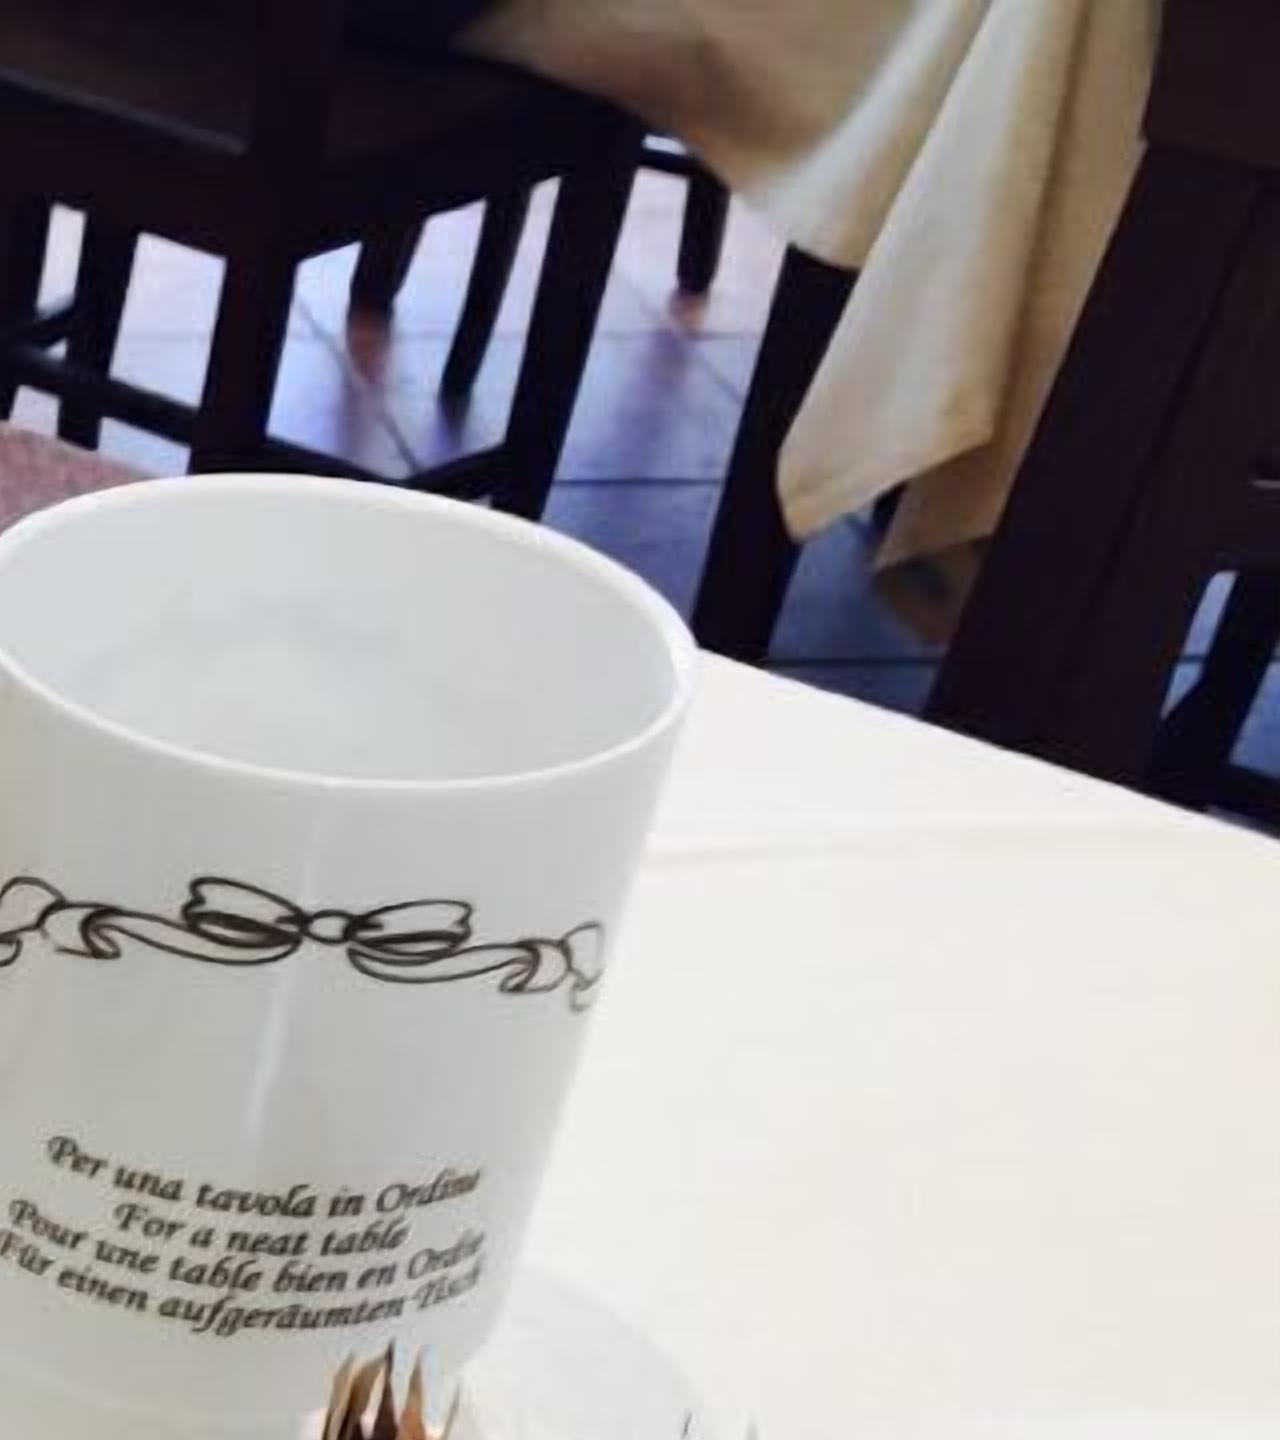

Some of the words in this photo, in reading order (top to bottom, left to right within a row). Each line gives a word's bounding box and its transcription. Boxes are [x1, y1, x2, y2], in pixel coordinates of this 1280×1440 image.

[48, 1135, 108, 1179] Per
[113, 1166, 184, 1201] una
[196, 1183, 316, 1217] tavola
[329, 1187, 364, 1217] in
[9, 1199, 88, 1248] Pour
[95, 1240, 160, 1273] une
[169, 1256, 263, 1292] table
[273, 1259, 348, 1293] bien
[357, 1263, 397, 1290] en
[113, 1203, 187, 1240] For
[190, 1228, 215, 1248] a
[227, 1231, 308, 1256] neat
[320, 1216, 411, 1257] table
[58, 1266, 149, 1312] einen
[159, 1294, 404, 1338] aufgeräumten
